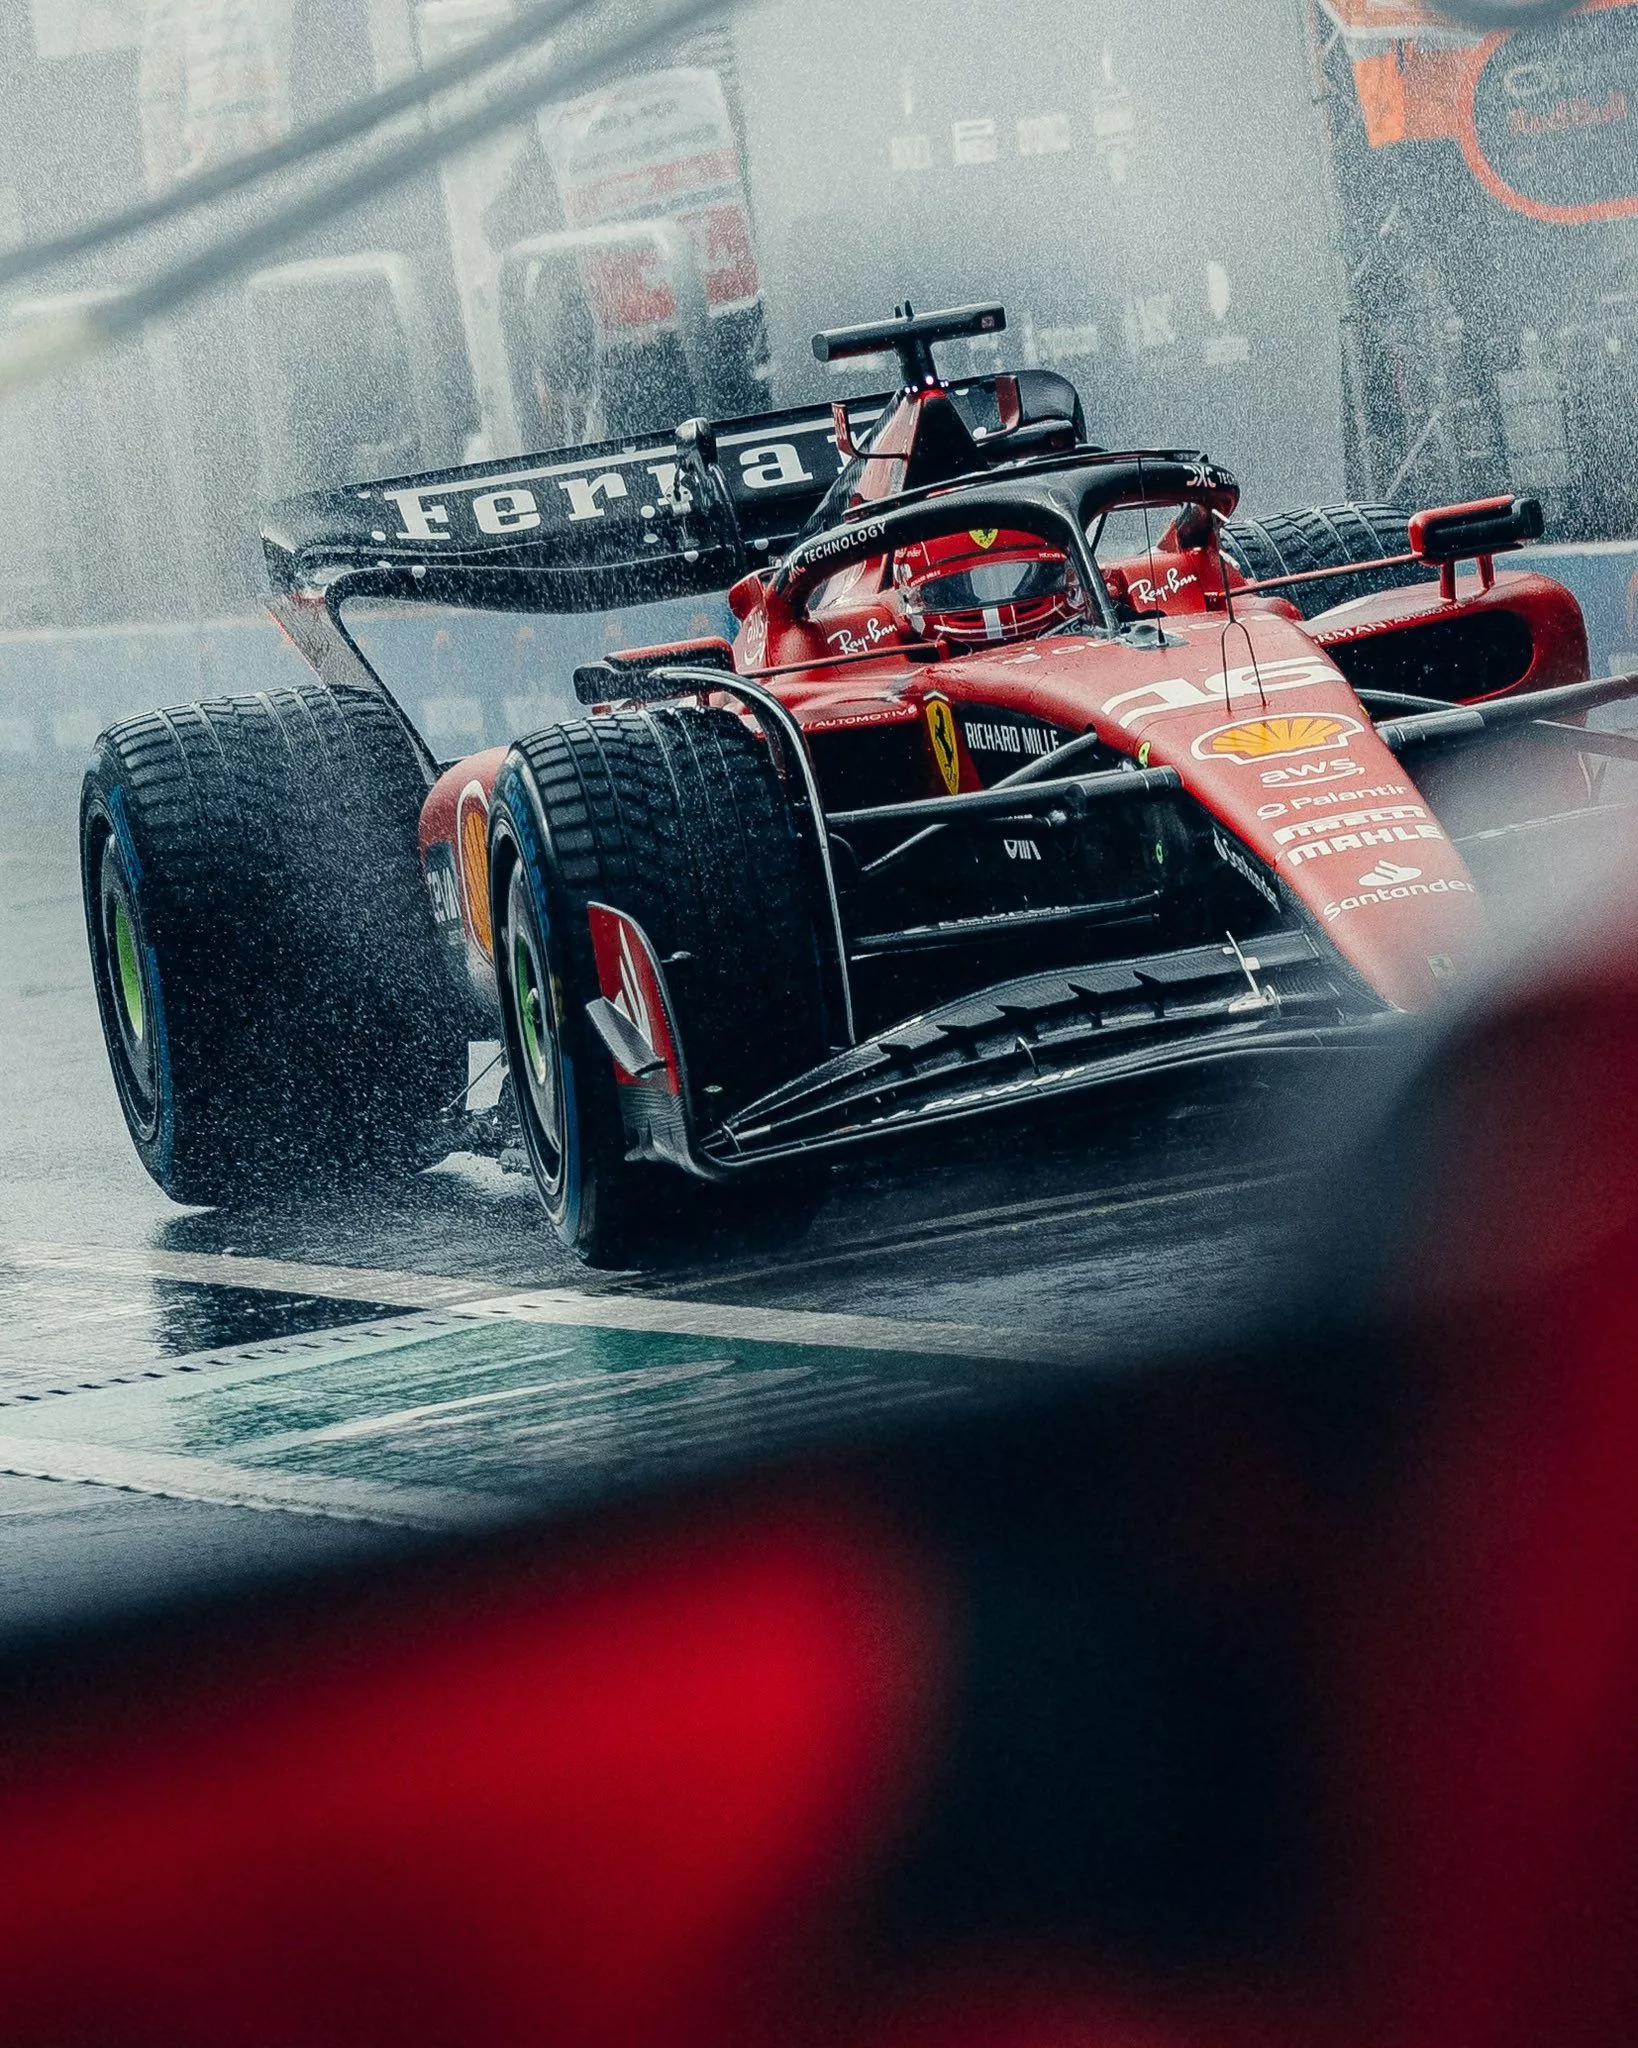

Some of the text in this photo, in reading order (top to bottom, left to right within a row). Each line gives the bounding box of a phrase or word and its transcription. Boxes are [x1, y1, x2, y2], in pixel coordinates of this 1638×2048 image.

[803, 520, 888, 564] TECHNOLOGY
[1127, 567, 1199, 605] Ray-Ban
[826, 617, 899, 655] Ray-Ban
[1100, 655, 1349, 729] 16
[814, 704, 918, 730] AUTOMOTIVE
[964, 721, 1060, 756] RICHARD MILLE
[1259, 757, 1359, 784] aws
[1292, 783, 1409, 812] Palantir
[1286, 823, 1446, 868] MAHLE
[1322, 878, 1478, 923] Santander
